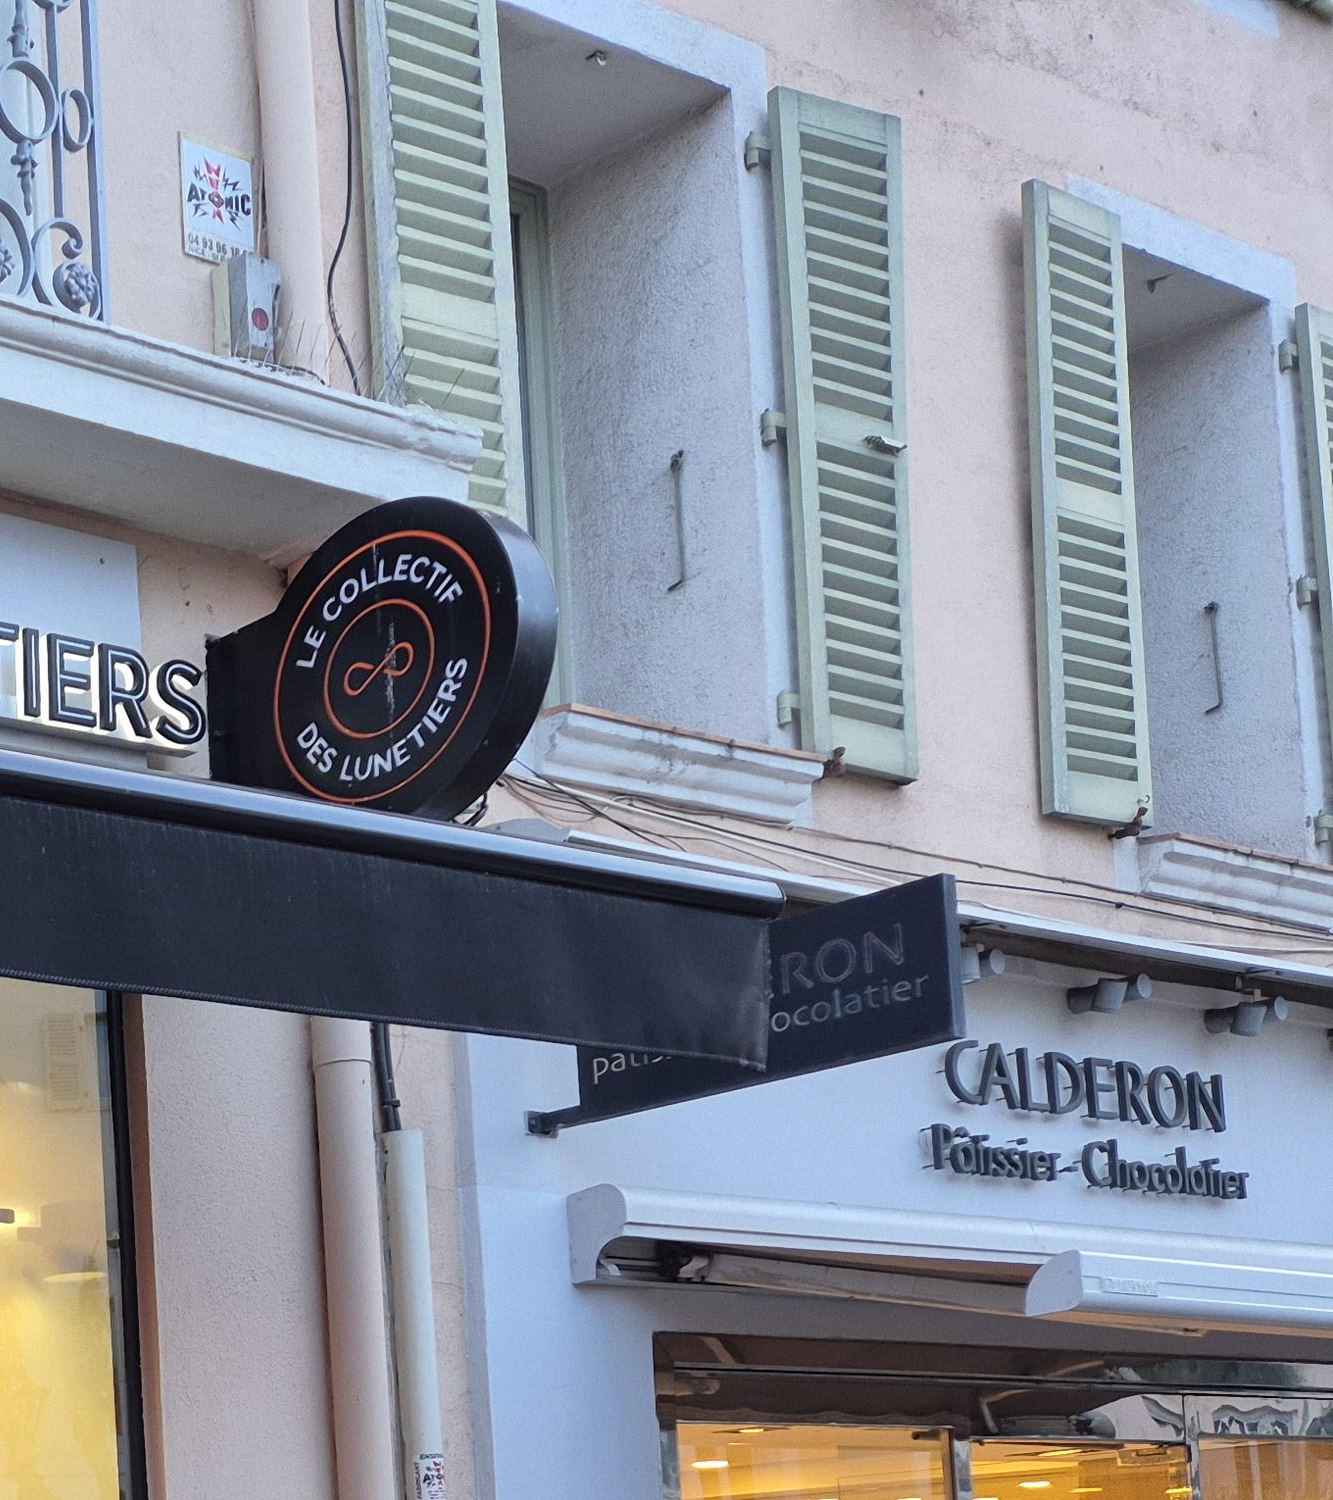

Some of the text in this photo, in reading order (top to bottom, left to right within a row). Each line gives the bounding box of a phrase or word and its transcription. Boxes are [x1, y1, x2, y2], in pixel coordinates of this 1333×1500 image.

[295, 553, 463, 669] LE COLLECTIF
[296, 657, 468, 782] DES LUNETIERS
[773, 922, 905, 995] RON
[771, 974, 930, 1033] ocolatier
[944, 1039, 1227, 1133] CALDERON
[931, 1123, 1061, 1181] Pâtissier
[1081, 1138, 1250, 1199] Chocolatier
